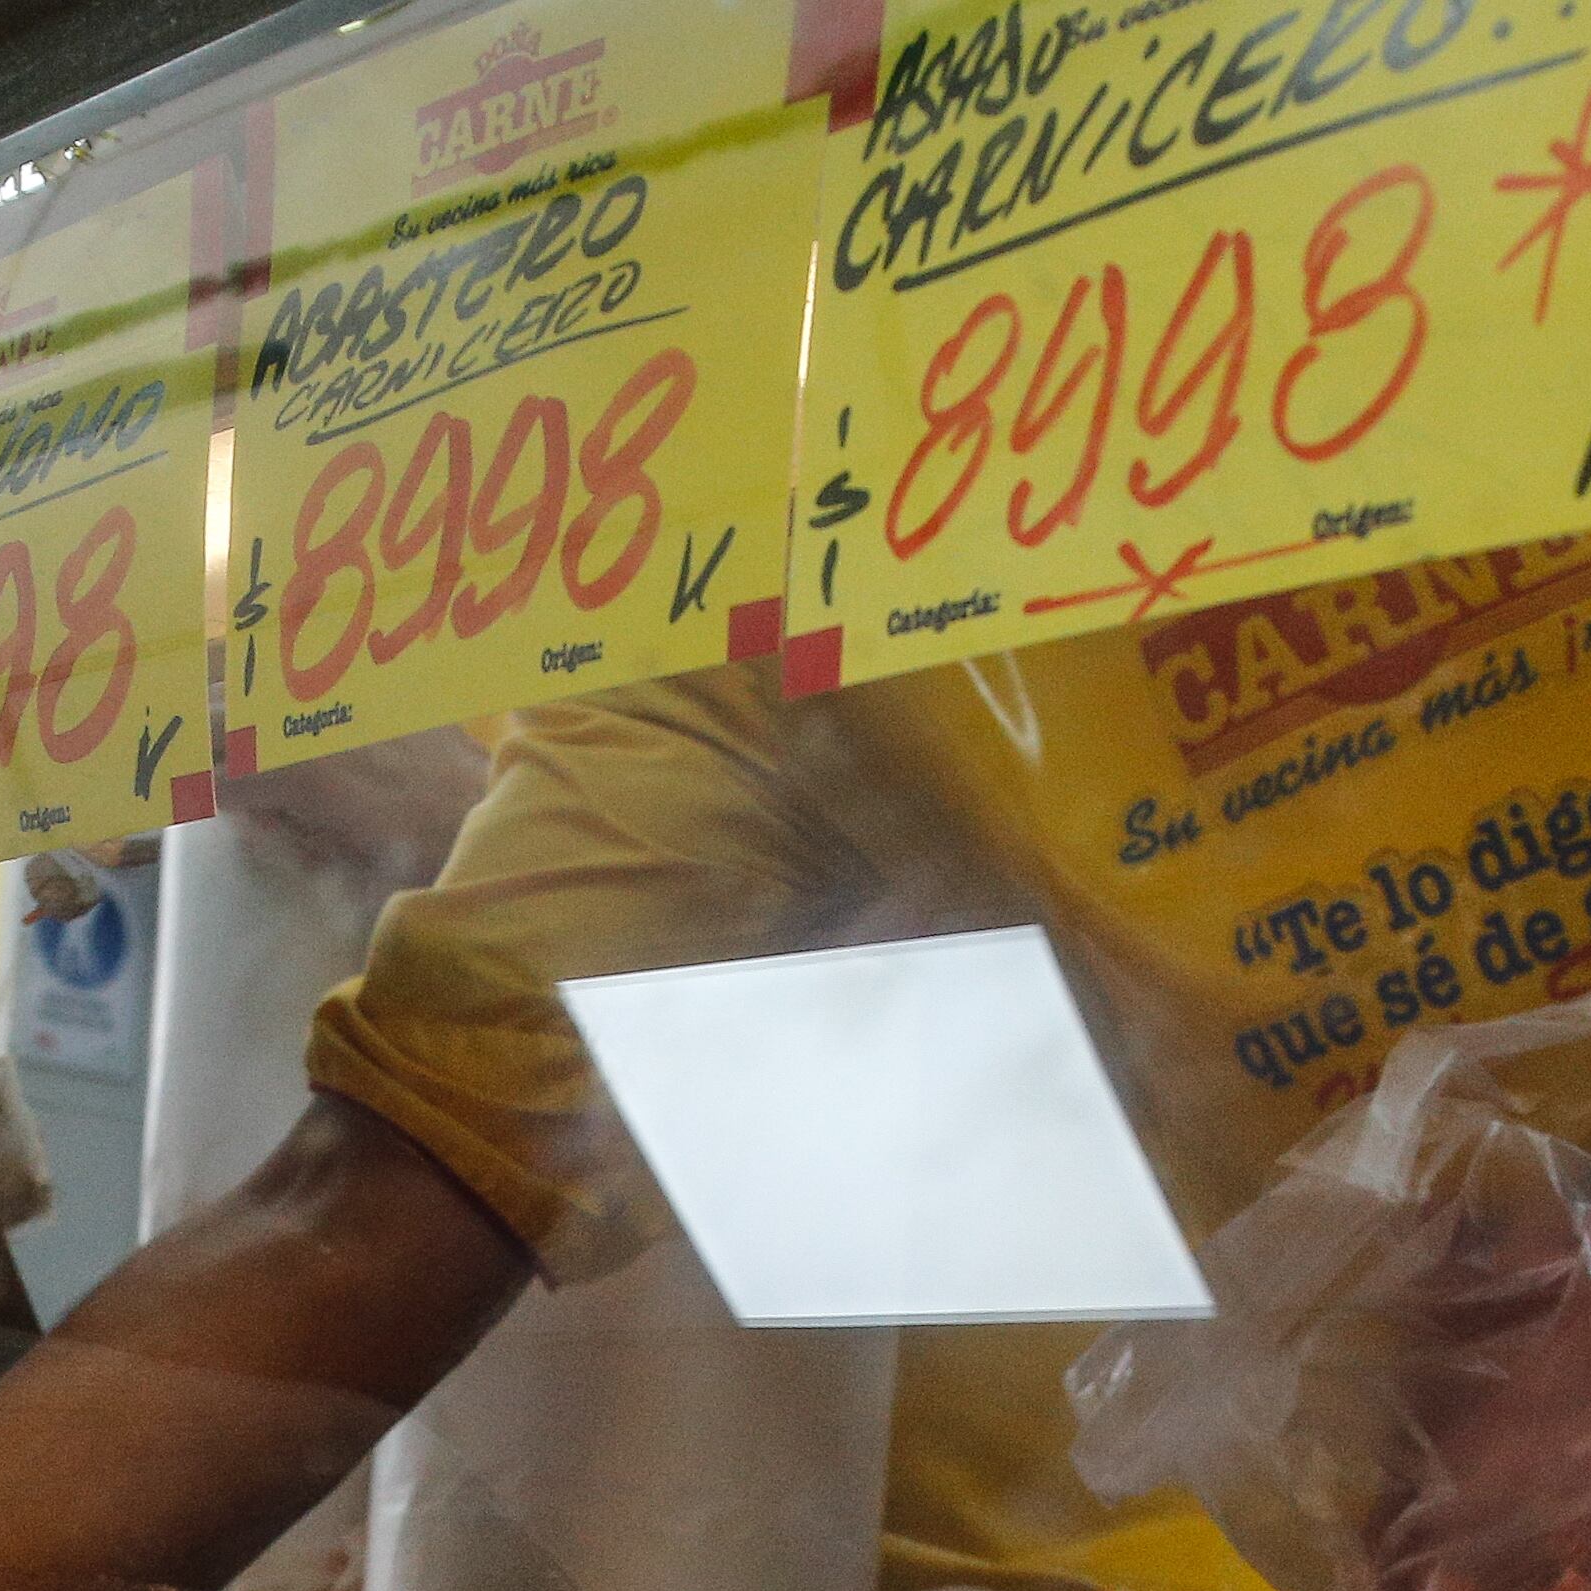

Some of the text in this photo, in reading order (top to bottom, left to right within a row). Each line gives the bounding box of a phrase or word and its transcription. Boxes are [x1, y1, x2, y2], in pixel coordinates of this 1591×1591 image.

[251, 175, 647, 400] ABASTERO
[884, 163, 1437, 562] 8998
[280, 348, 697, 702] 8998
[540, 638, 604, 675] Origen:
[1117, 798, 1202, 866] Su
[1221, 718, 1399, 824] vecina
[1419, 645, 1541, 735] más
[1234, 993, 1365, 1089] que
[1376, 932, 1464, 1030] sé
[1474, 907, 1572, 986] de
[1369, 860, 1456, 932] lo
